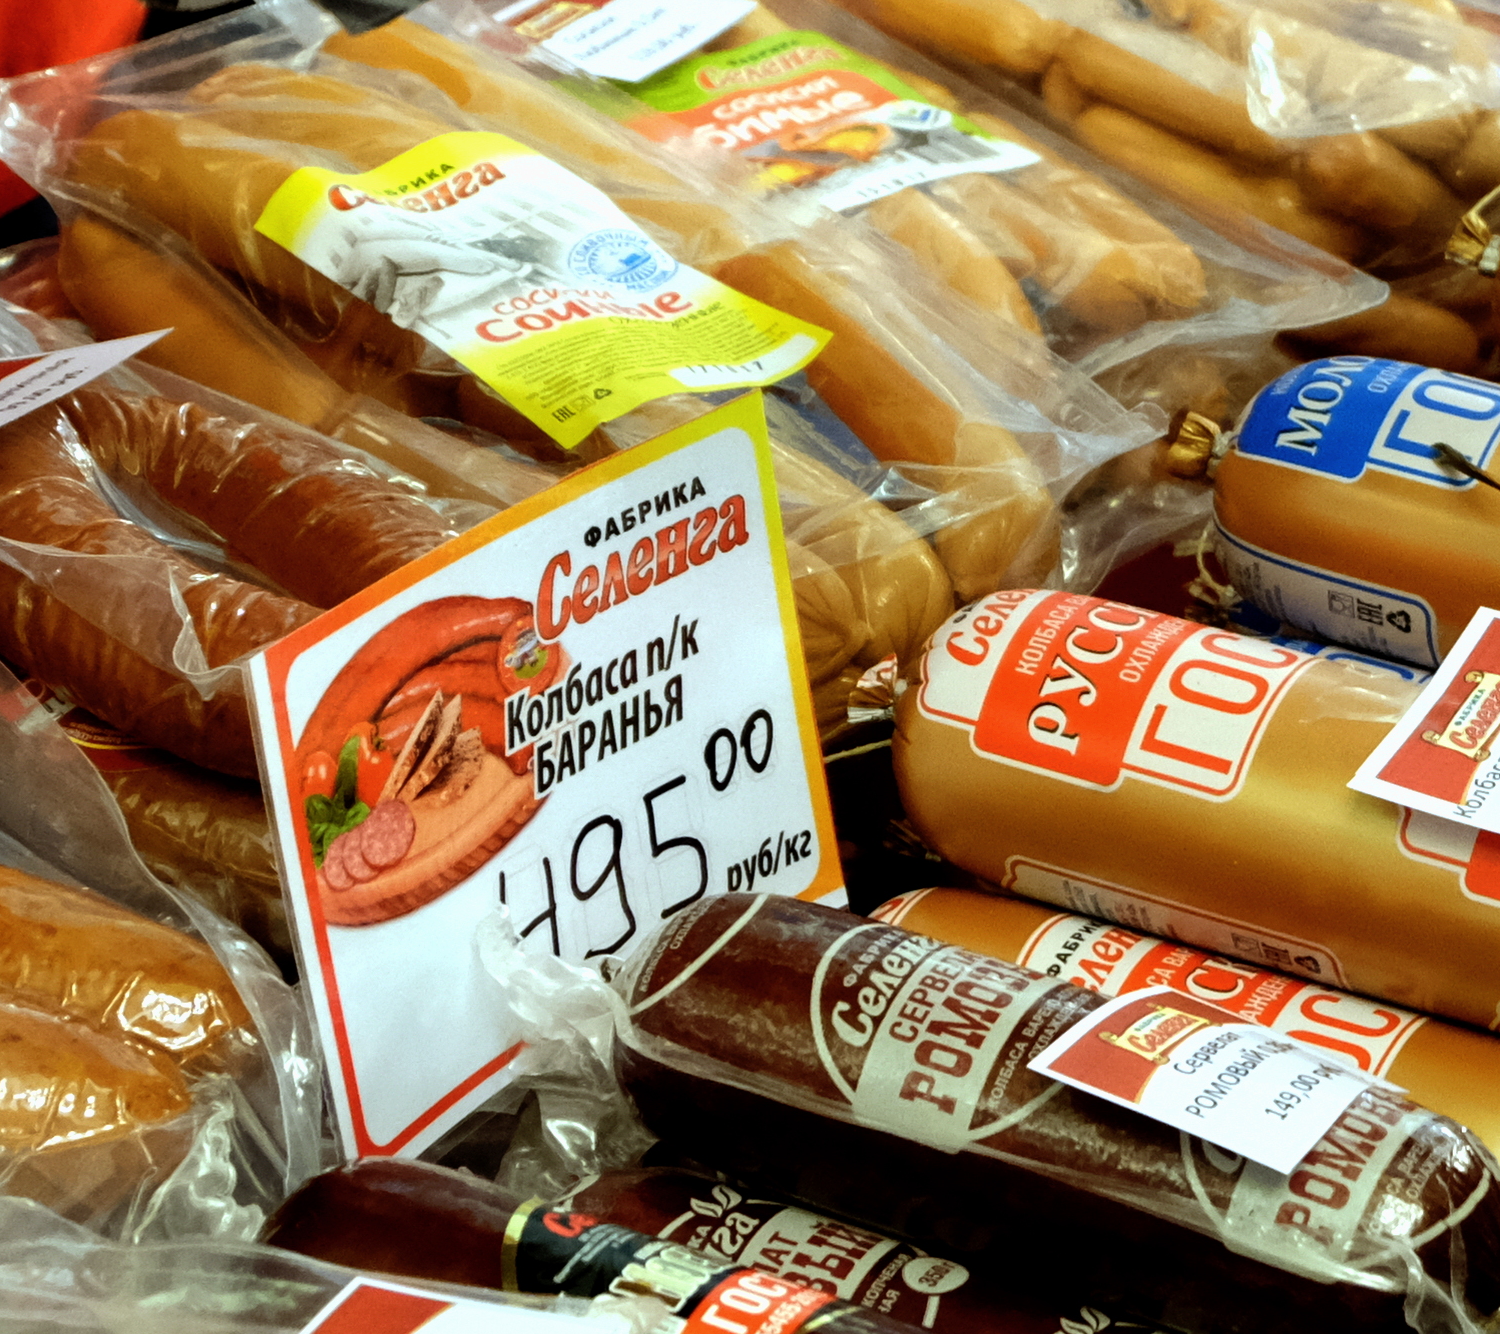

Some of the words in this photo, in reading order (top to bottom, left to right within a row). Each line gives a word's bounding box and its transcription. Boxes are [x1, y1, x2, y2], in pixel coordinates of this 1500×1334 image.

[583, 475, 707, 548] ФАБРИКА
[533, 493, 750, 643] Селенга
[1014, 603, 1074, 677] КОЛБАСА
[505, 643, 639, 758] Колбаса
[644, 614, 701, 685] п/к
[531, 672, 685, 797] БАРАНЬЯ
[498, 773, 710, 963] 495
[703, 708, 776, 793] 00
[726, 828, 814, 894] руб/кг
[1173, 1030, 1240, 1077] Сервелат
[1185, 1043, 1270, 1120] РОМОВЫЙ
[1264, 1074, 1322, 1122] 149,00
